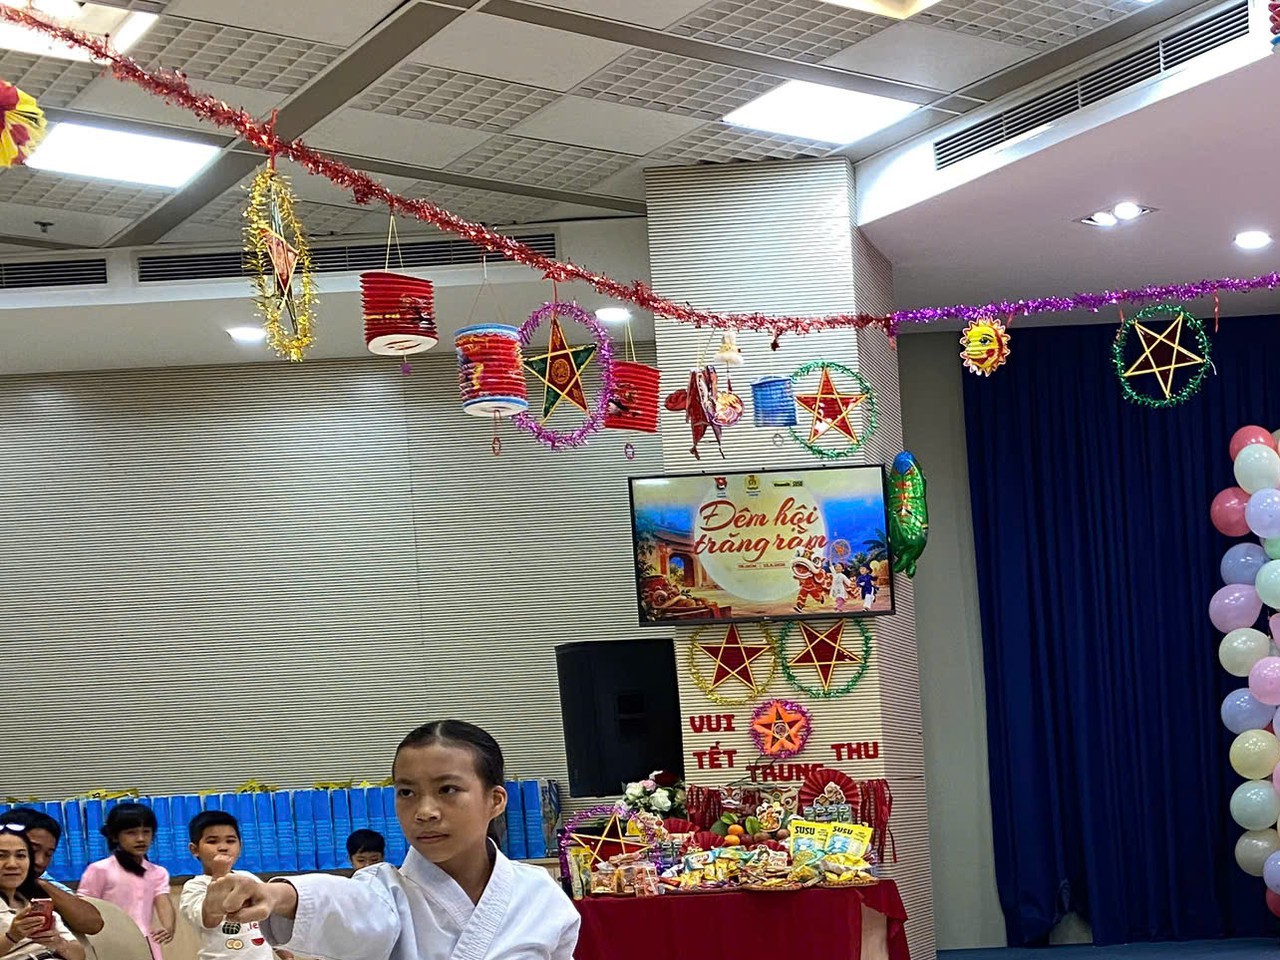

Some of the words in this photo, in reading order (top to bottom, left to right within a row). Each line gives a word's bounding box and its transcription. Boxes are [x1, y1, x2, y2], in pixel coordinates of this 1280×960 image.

[700, 499, 769, 531] Đêm
[774, 497, 819, 532] hội
[694, 533, 770, 563] trăng
[772, 524, 828, 550] rằm
[690, 714, 735, 733] VUI
[693, 742, 737, 769] TẾT
[831, 742, 879, 761] THU
[794, 825, 815, 835] SUSU
[832, 825, 853, 835] SUSU
